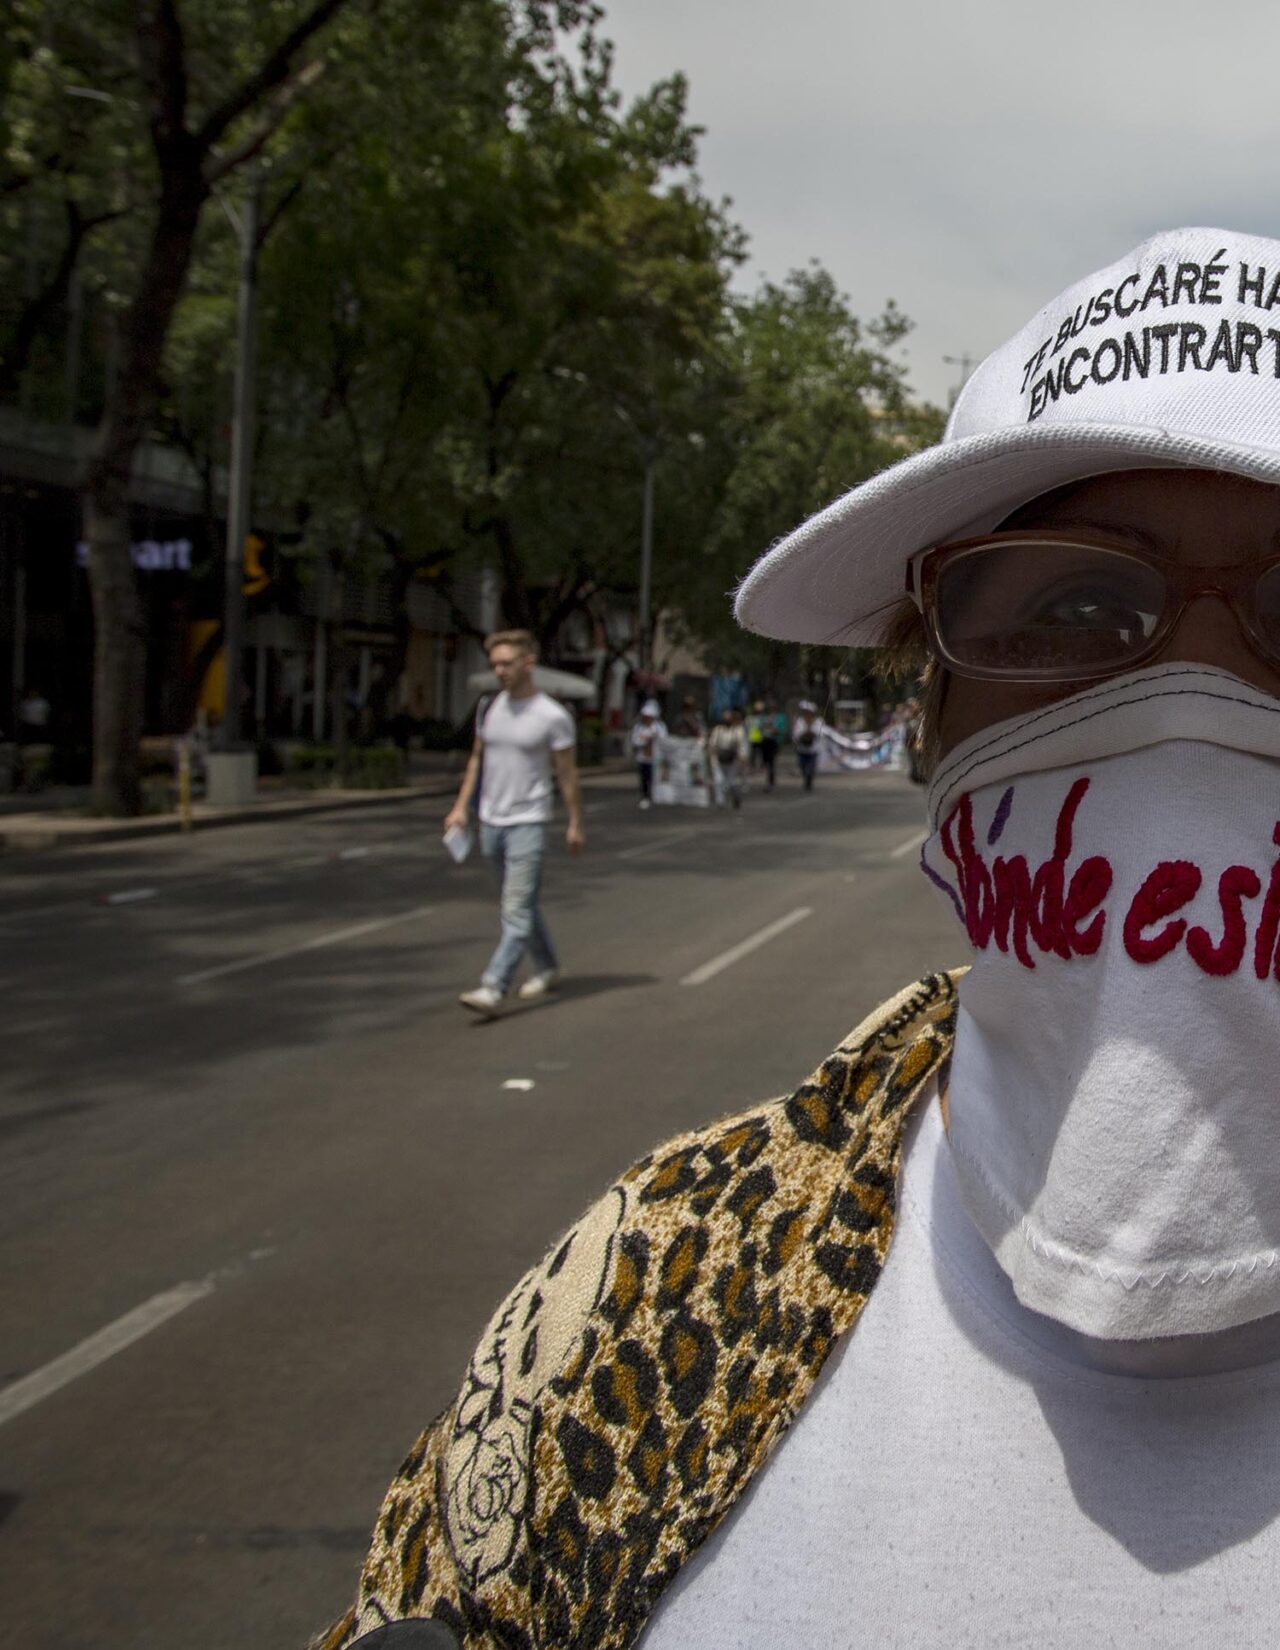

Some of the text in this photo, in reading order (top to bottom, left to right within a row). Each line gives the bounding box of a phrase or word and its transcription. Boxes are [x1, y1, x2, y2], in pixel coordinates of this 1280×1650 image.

[1020, 335, 1053, 395] TE
[1049, 248, 1229, 358] BUSCARÉ
[76, 538, 193, 571] sart
